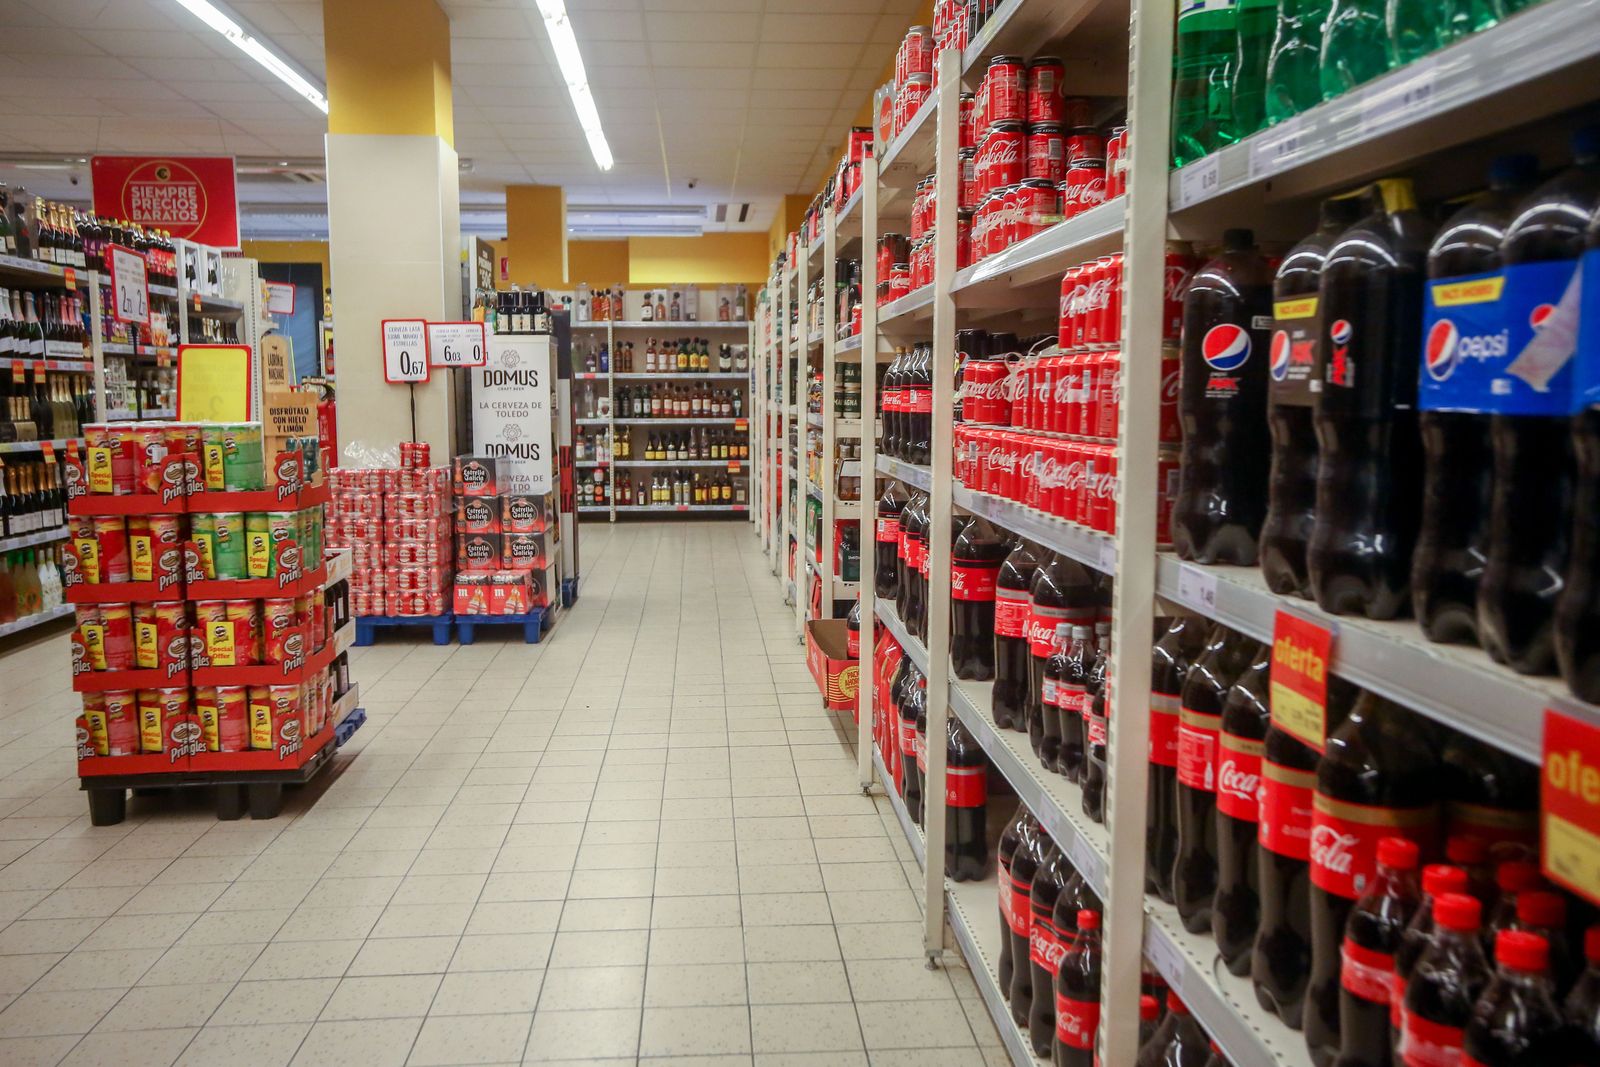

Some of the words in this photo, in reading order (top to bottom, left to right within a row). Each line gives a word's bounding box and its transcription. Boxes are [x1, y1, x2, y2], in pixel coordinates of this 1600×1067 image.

[131, 186, 197, 198] SIEMPRE
[132, 198, 198, 210] PRECIOS
[132, 209, 199, 221] BARATOS
[1458, 329, 1508, 363] pepsi
[444, 345, 461, 363] 6,03
[473, 345, 489, 362] 0,1
[400, 351, 424, 376] 0,67
[483, 370, 539, 388] DOMUS
[269, 406, 309, 415] DISFRÚTALO
[495, 410, 529, 418] TOLEDO
[272, 416, 287, 424] CON
[288, 416, 307, 424] HIELO
[283, 423, 304, 433] LIMÓN
[485, 443, 540, 461] DOMUS
[1275, 636, 1323, 683] oferta
[1548, 750, 1600, 805] ofe
